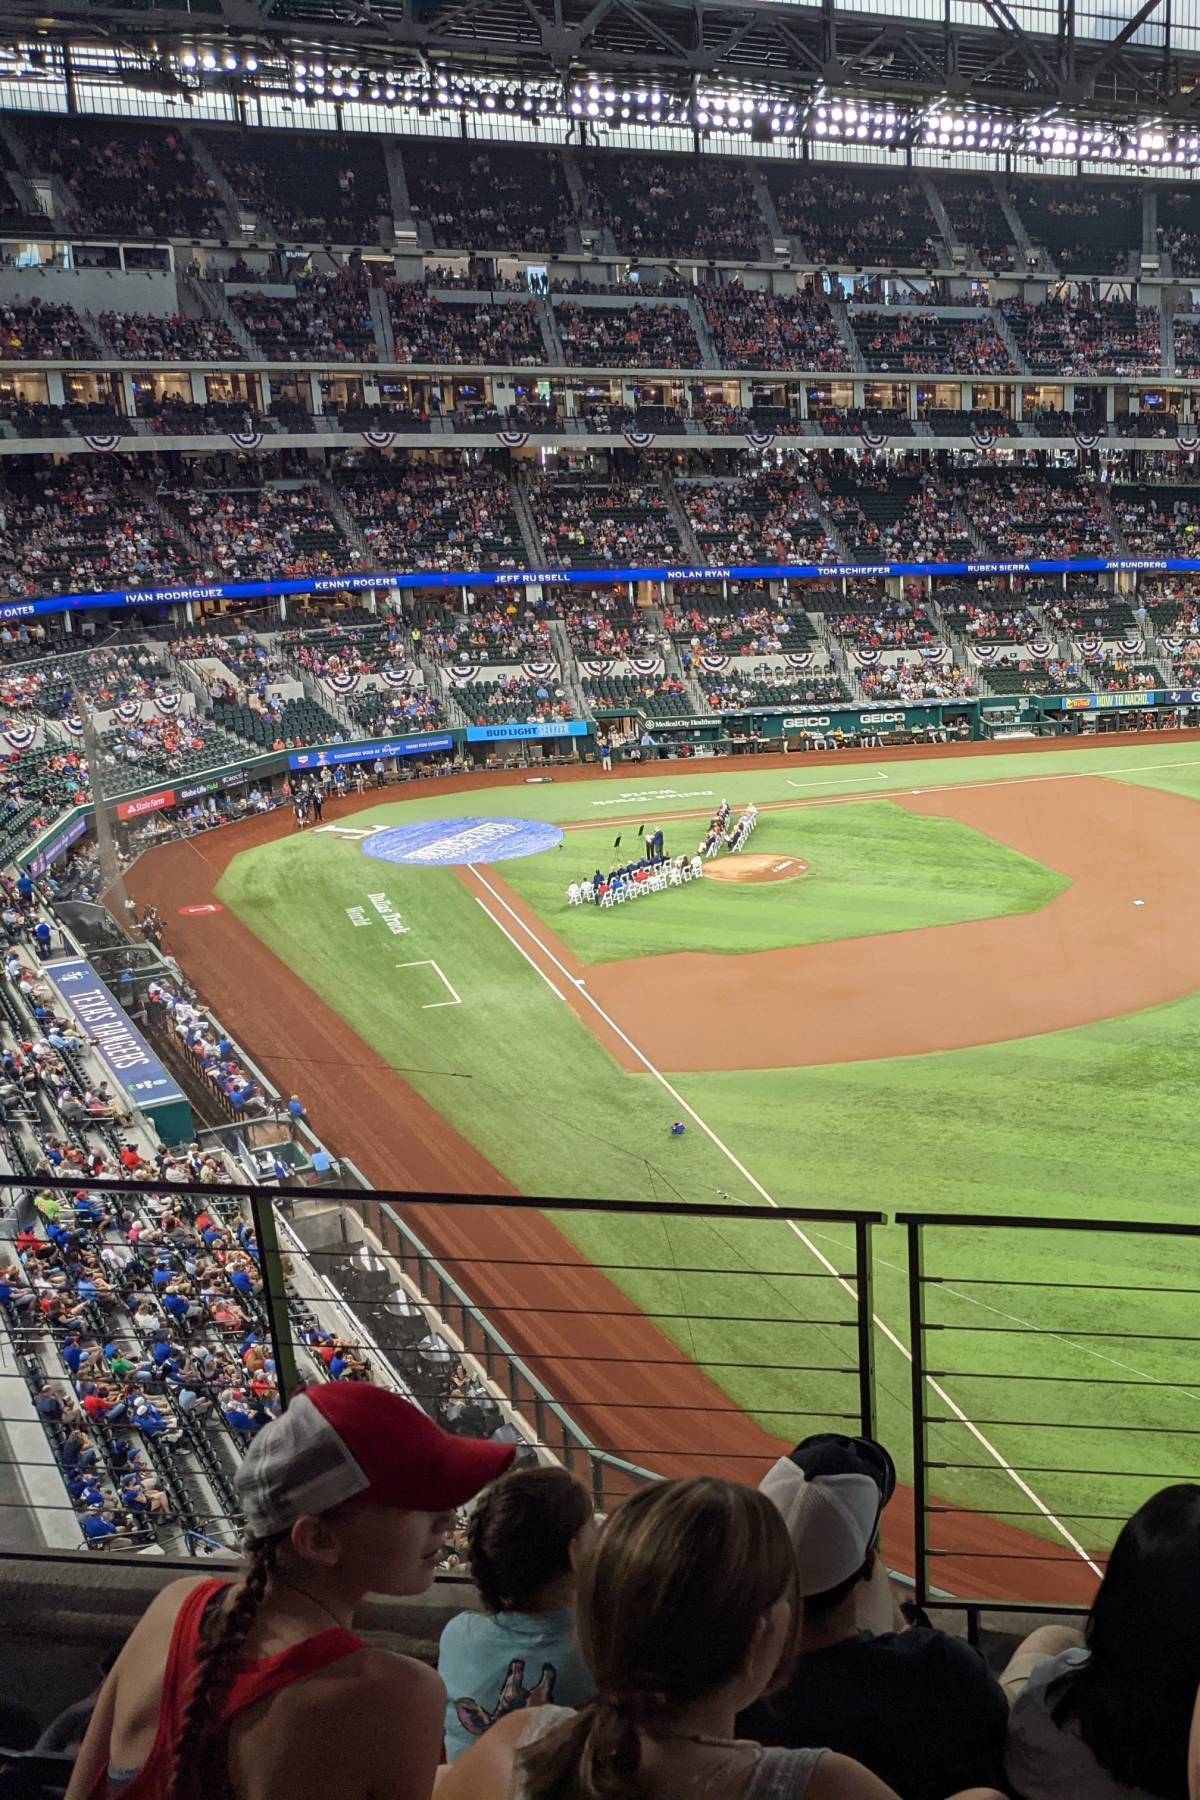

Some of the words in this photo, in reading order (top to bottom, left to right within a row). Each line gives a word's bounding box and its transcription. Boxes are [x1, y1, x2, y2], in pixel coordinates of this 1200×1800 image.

[705, 570, 730, 578] RYAN
[840, 567, 890, 575] SCHIEFFER
[315, 580, 350, 590] KENNY
[353, 578, 397, 587] ROGERS
[494, 575, 520, 583] JEFF
[522, 574, 571, 582] RUSSELL
[125, 593, 153, 603] IVÁN
[156, 588, 223, 601] RODRÍGUEZ
[4, 605, 35, 617] OATES
[1113, 694, 1125, 705] TO
[655, 720, 678, 728] Medical
[678, 720, 690, 728] City
[783, 717, 830, 728] GEICO
[860, 712, 906, 724] GEICO
[486, 729, 507, 737] BUD
[508, 727, 538, 736] LIGHT
[181, 788, 197, 798] Globe
[196, 785, 207, 794] Life
[206, 782, 219, 791] Field
[345, 906, 373, 927] World
[367, 892, 393, 913] Dallas
[382, 912, 411, 935] Truck
[70, 988, 117, 1023] TEXAS
[89, 1020, 150, 1070] RANGERS
